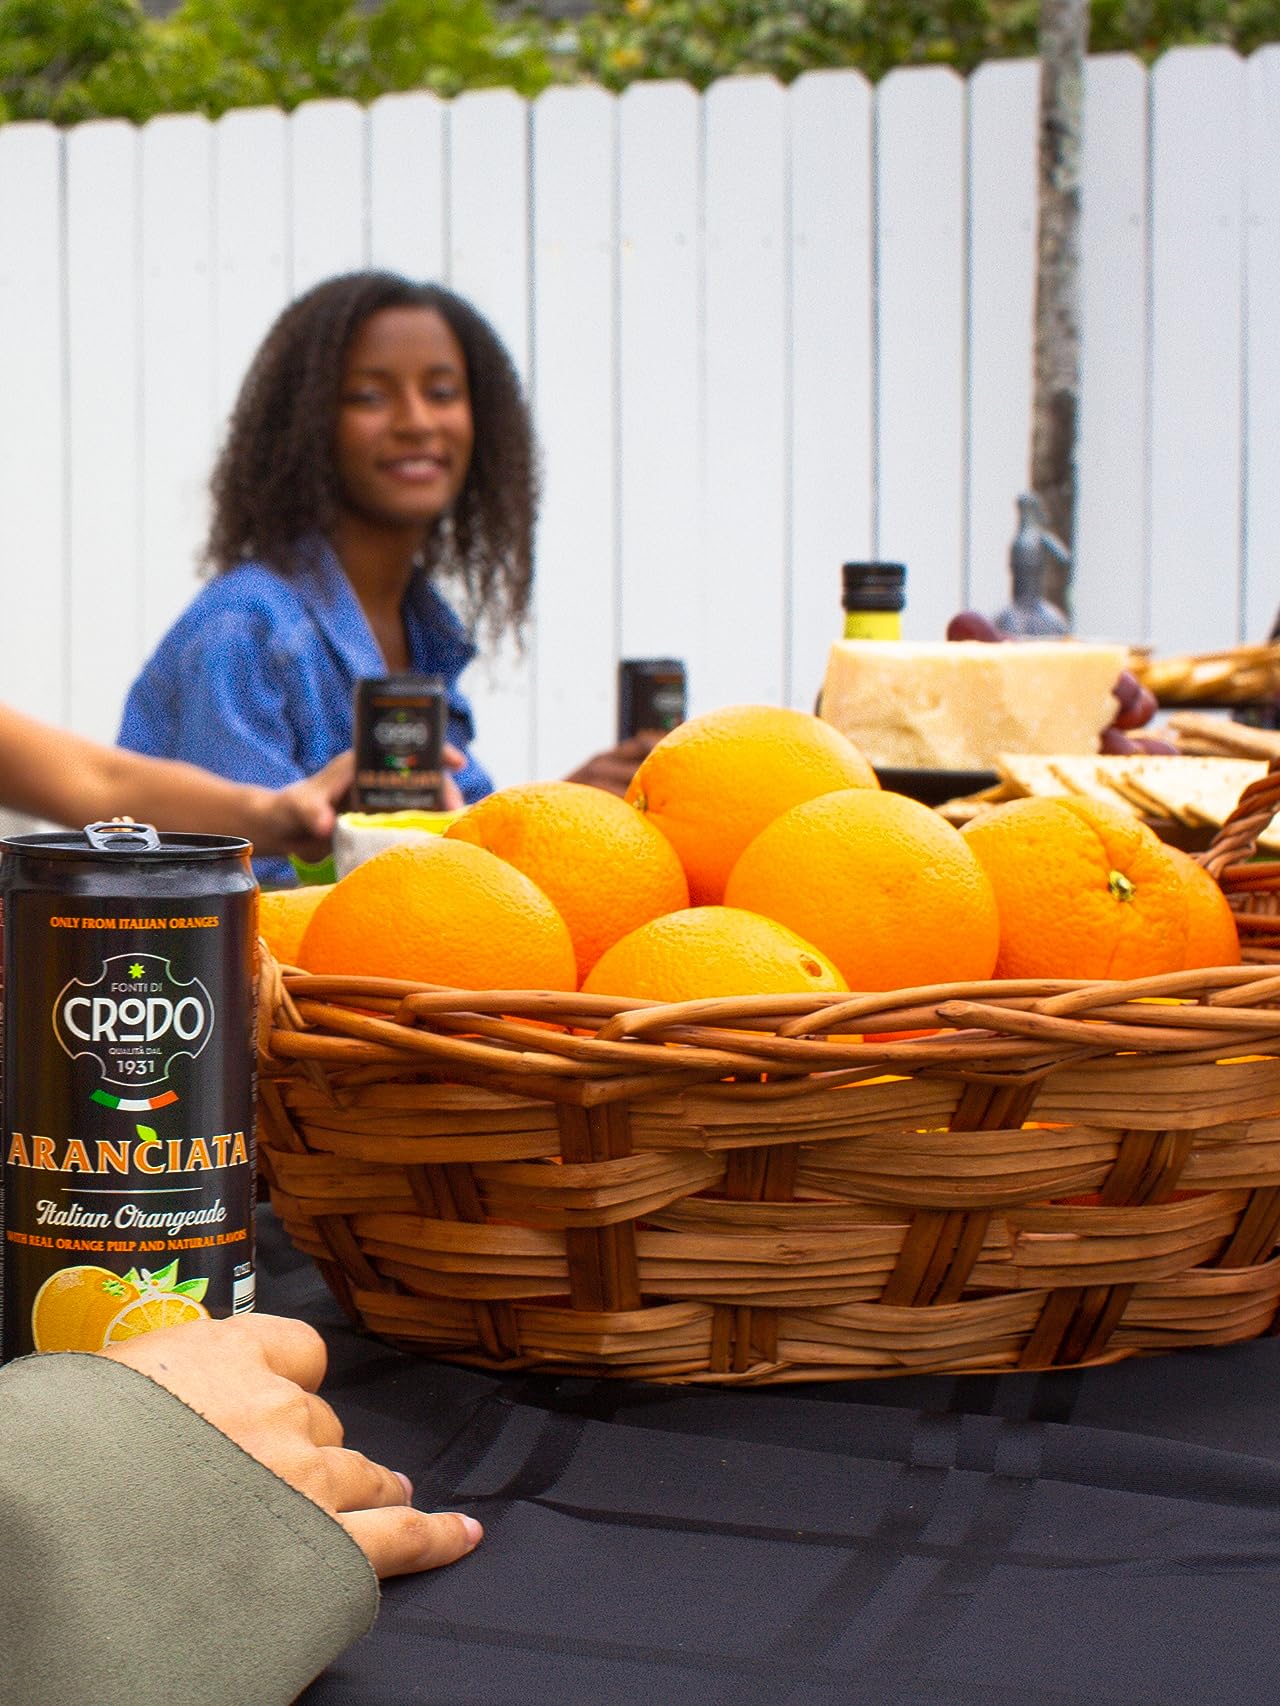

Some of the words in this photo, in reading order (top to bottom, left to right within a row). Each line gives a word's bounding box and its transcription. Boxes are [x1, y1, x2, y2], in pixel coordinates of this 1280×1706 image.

[50, 916, 80, 929] ONLY
[82, 917, 117, 930] FROM
[119, 918, 168, 930] ITALIAN
[169, 916, 220, 929] ORANGES
[111, 982, 148, 993] FONTI
[150, 982, 164, 993] DI
[63, 996, 205, 1042] CRODO
[146, 1047, 163, 1056] DAL
[116, 1060, 155, 1076] 1931
[6, 1131, 249, 1175] ARANCIATA
[35, 1199, 112, 1229] Italian
[113, 1198, 228, 1236] Orangeade
[29, 1234, 54, 1249] REAL
[55, 1238, 105, 1252] ORANGE
[106, 1240, 138, 1253] PULP
[138, 1239, 166, 1252] AND
[167, 1235, 216, 1251] NATURAL
[217, 1228, 248, 1246] FLAVORS
